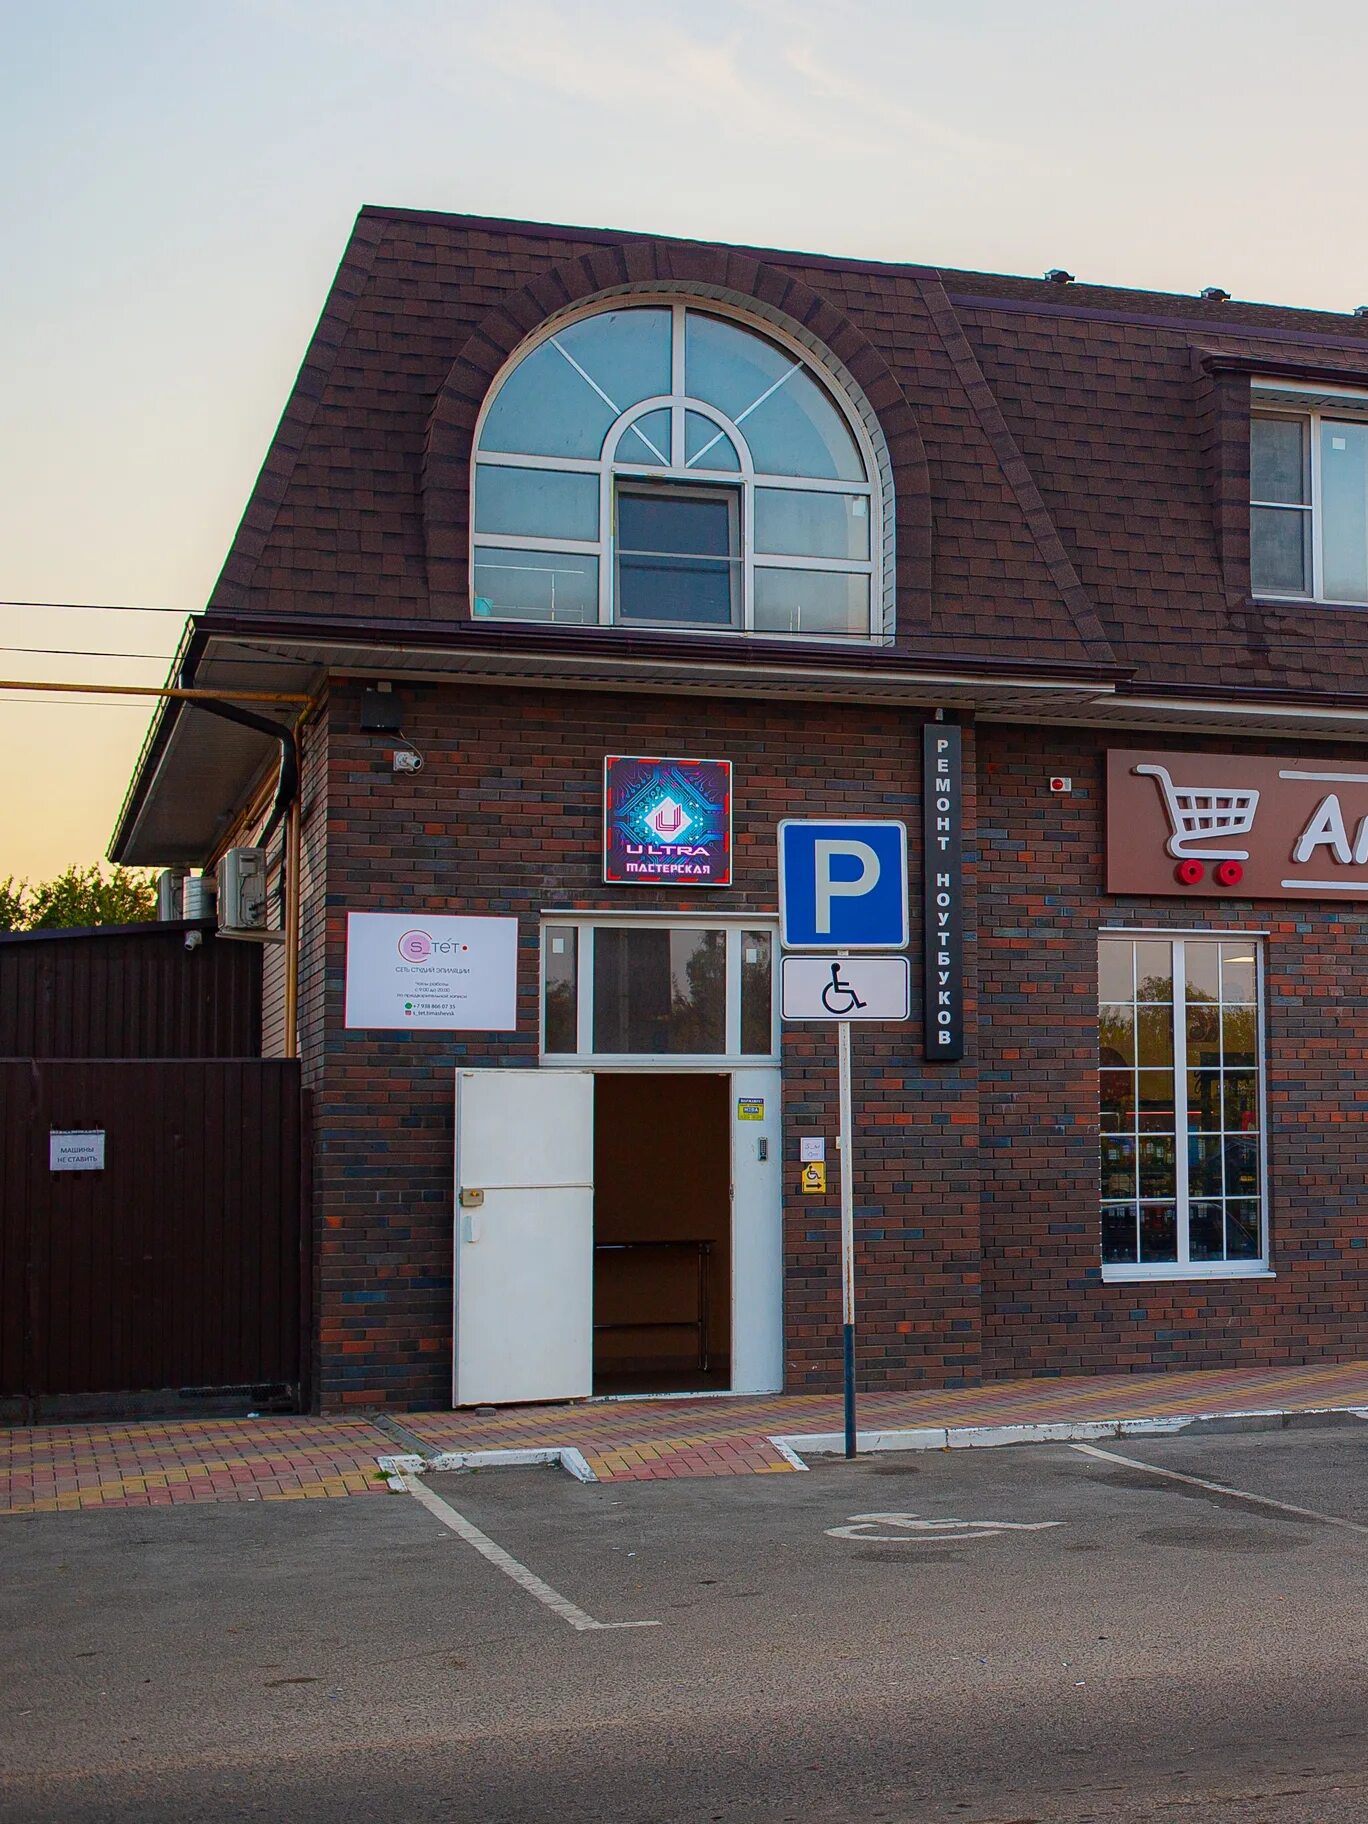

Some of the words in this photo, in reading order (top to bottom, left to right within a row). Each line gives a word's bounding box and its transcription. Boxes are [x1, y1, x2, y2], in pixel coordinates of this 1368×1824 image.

[936, 739, 951, 851] РЕМОНТ
[626, 845, 711, 857] ULTRA
[626, 863, 711, 874] МАСТЕРСКАЯ
[814, 839, 881, 934] P
[411, 966, 435, 974] СТУДИЙ
[936, 873, 952, 1045] НОУТБУКОВ
